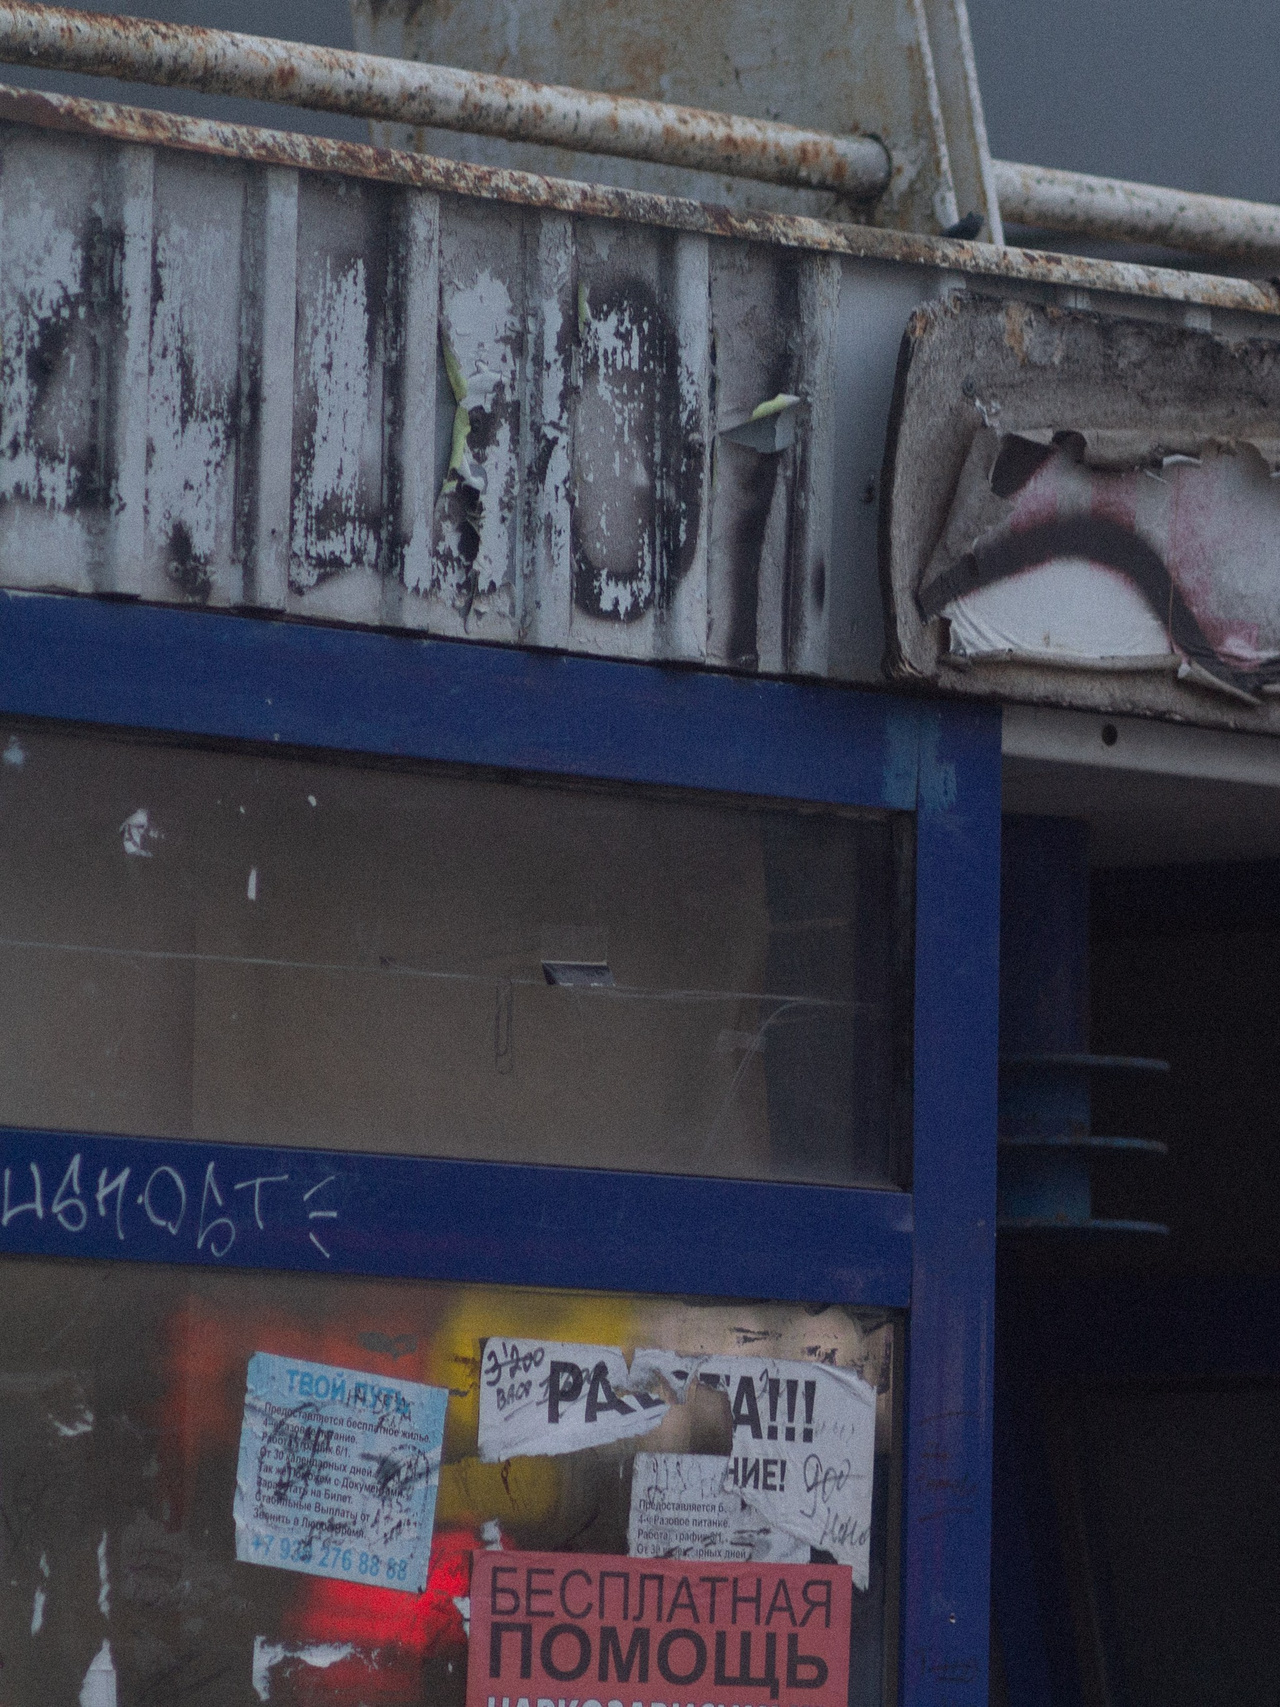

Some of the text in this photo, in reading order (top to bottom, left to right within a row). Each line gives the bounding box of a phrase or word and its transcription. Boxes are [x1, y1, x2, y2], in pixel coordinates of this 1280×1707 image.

[286, 1369, 346, 1402] ТВОЙ
[274, 1449, 284, 1459] 30
[311, 1488, 321, 1498] на
[314, 1501, 358, 1520] Выплаты
[360, 1512, 371, 1522] от
[319, 1546, 352, 1571] 276
[359, 1552, 380, 1577] 88
[490, 1566, 832, 1628] БЕСПЛАТНАЯ
[489, 1621, 829, 1699] ПОМОЩЬ
